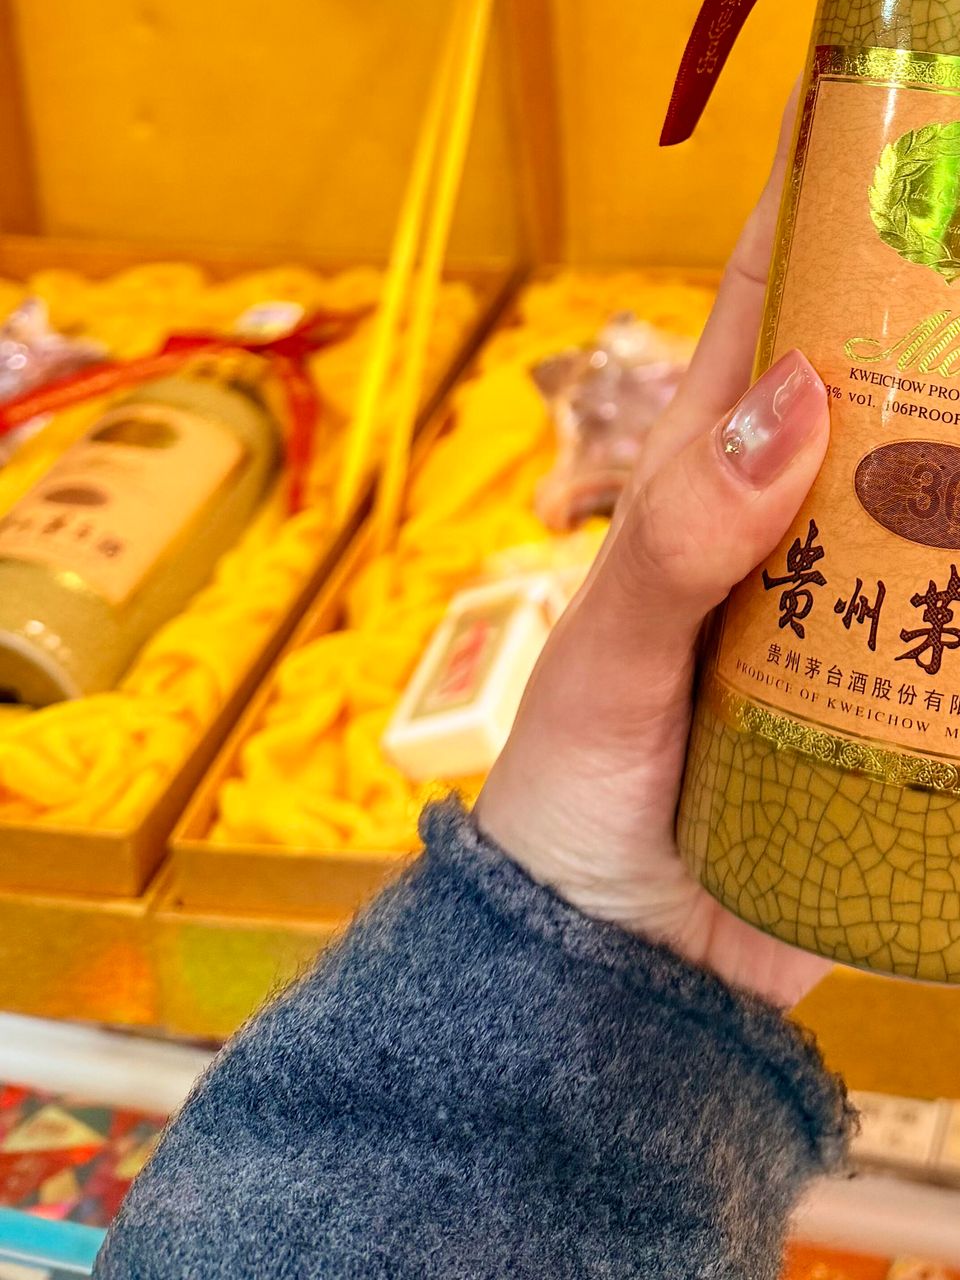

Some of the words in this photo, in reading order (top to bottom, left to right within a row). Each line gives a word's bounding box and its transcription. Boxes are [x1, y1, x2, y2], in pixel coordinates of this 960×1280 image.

[825, 384, 843, 400] 3%
[848, 367, 926, 394] KWEICHOW
[736, 658, 793, 695] PRODUCE
[799, 688, 820, 703] OF
[827, 697, 930, 733] KWEICHOW
